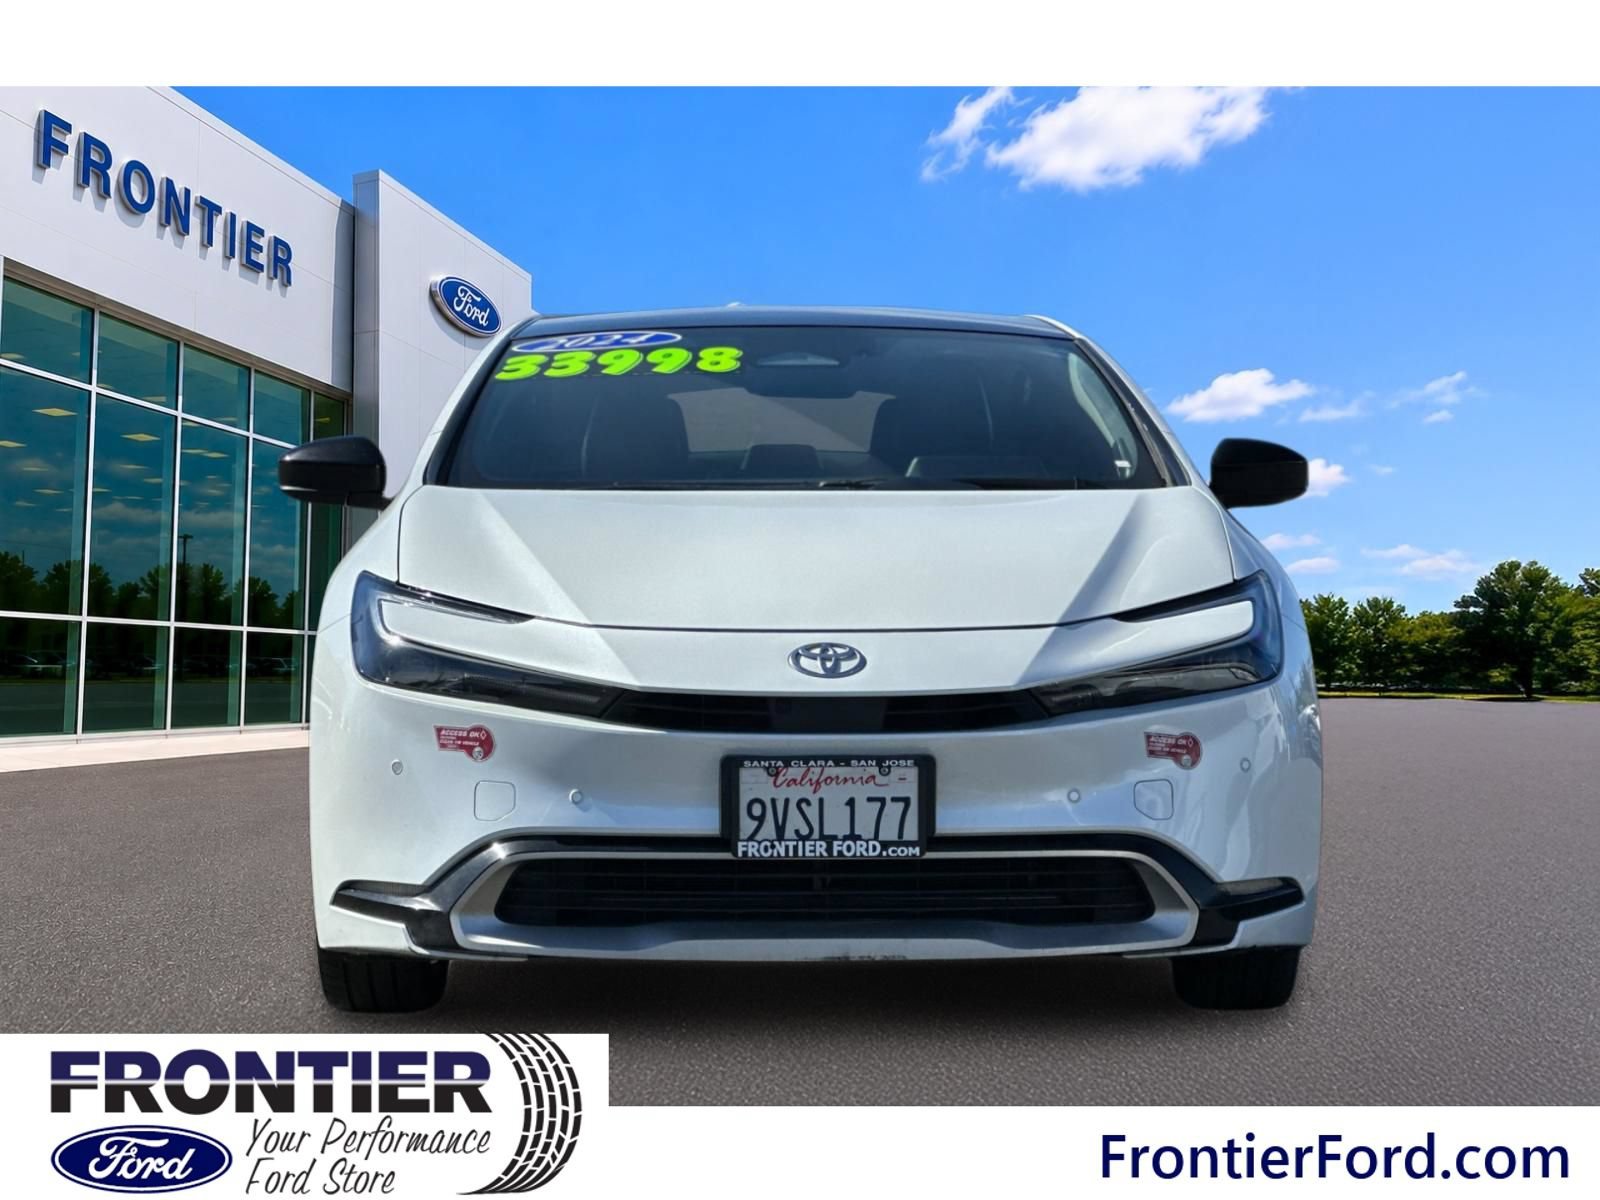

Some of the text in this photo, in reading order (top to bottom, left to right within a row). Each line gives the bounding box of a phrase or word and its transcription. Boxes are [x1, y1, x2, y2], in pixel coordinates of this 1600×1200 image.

[37, 108, 293, 287] FRONTIER
[453, 285, 490, 327] Ford
[533, 333, 656, 350] 2024
[495, 347, 743, 380] 33998
[743, 759, 784, 768] SANTA
[791, 759, 835, 768] CLARA
[851, 759, 876, 768] SAN
[882, 759, 914, 768] JOSE
[773, 767, 888, 794] California
[746, 796, 911, 841] 9VSL177
[737, 840, 829, 857] FRONTIER
